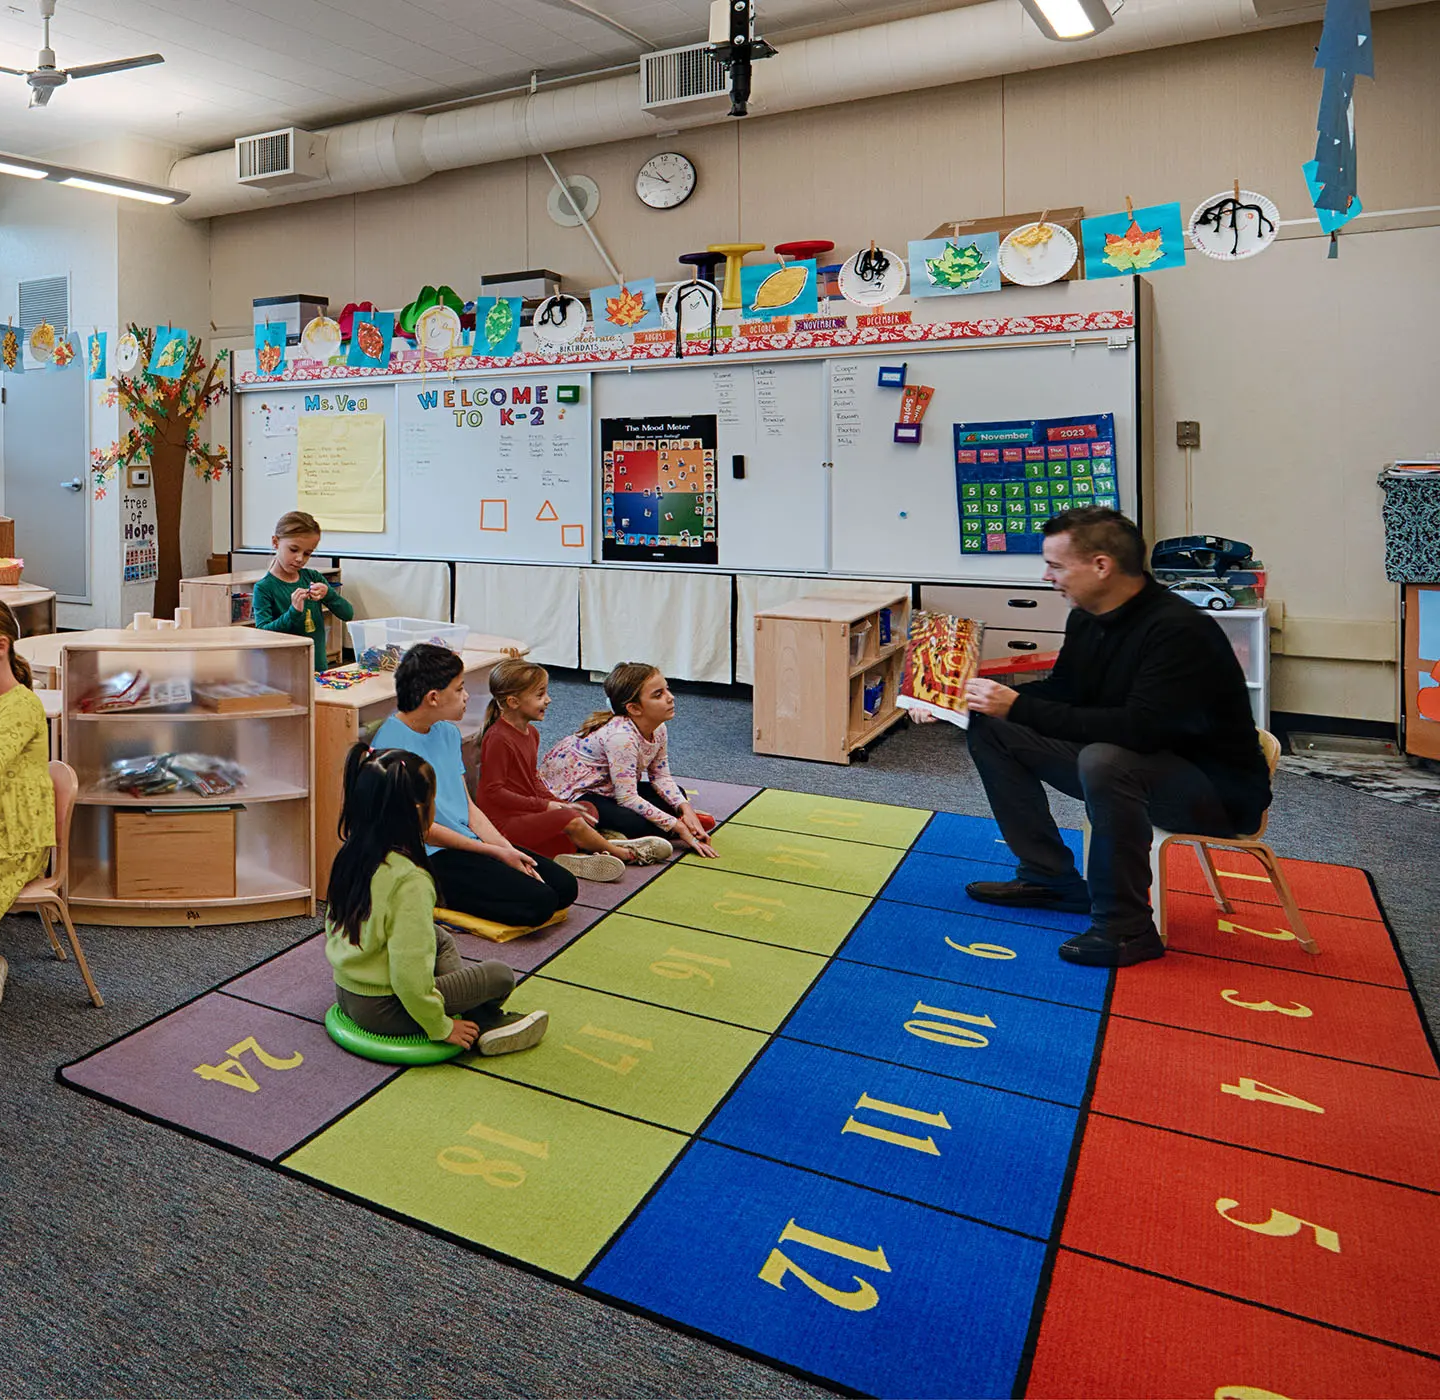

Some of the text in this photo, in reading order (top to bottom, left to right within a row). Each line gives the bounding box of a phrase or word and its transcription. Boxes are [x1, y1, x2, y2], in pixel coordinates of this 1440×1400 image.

[749, 324, 776, 335] OCTOBER
[804, 319, 837, 330] NOVEMBER
[866, 313, 900, 326] DECEMBER
[644, 332, 666, 342] AUGUST
[560, 344, 599, 354] BIRTHDAYS
[305, 394, 367, 411] Ms. Vea
[417, 385, 548, 410] WELCOME
[453, 407, 545, 427] TO K-2
[980, 429, 1085, 441] November 2023
[1032, 462, 1107, 475] 1 2 3 4
[968, 481, 1111, 496] 5 6 7 8 9 10 11
[124, 495, 148, 509] tree
[966, 504, 979, 513] 12
[986, 503, 999, 513] 13
[1009, 503, 1023, 512] 14
[1033, 503, 1046, 512] 15
[1056, 502, 1070, 511] 16
[131, 510, 142, 524] of
[966, 522, 979, 531] 19
[988, 522, 1003, 531] 20
[1010, 521, 1024, 530] 21
[125, 524, 155, 540] Hope
[965, 539, 979, 548] 26
[766, 843, 830, 870] 14
[713, 890, 787, 922] 15
[1218, 919, 1296, 941] 2
[945, 936, 1016, 960] 9
[649, 945, 734, 988] 16
[1220, 989, 1313, 1018] 3
[903, 1000, 997, 1048] 10
[564, 1022, 654, 1076] 17
[192, 1036, 304, 1093] 24
[1220, 1077, 1325, 1114] 4
[841, 1091, 952, 1156] 11
[436, 1122, 550, 1189] 18
[1215, 1197, 1341, 1253] 5
[758, 1217, 892, 1312] 12
